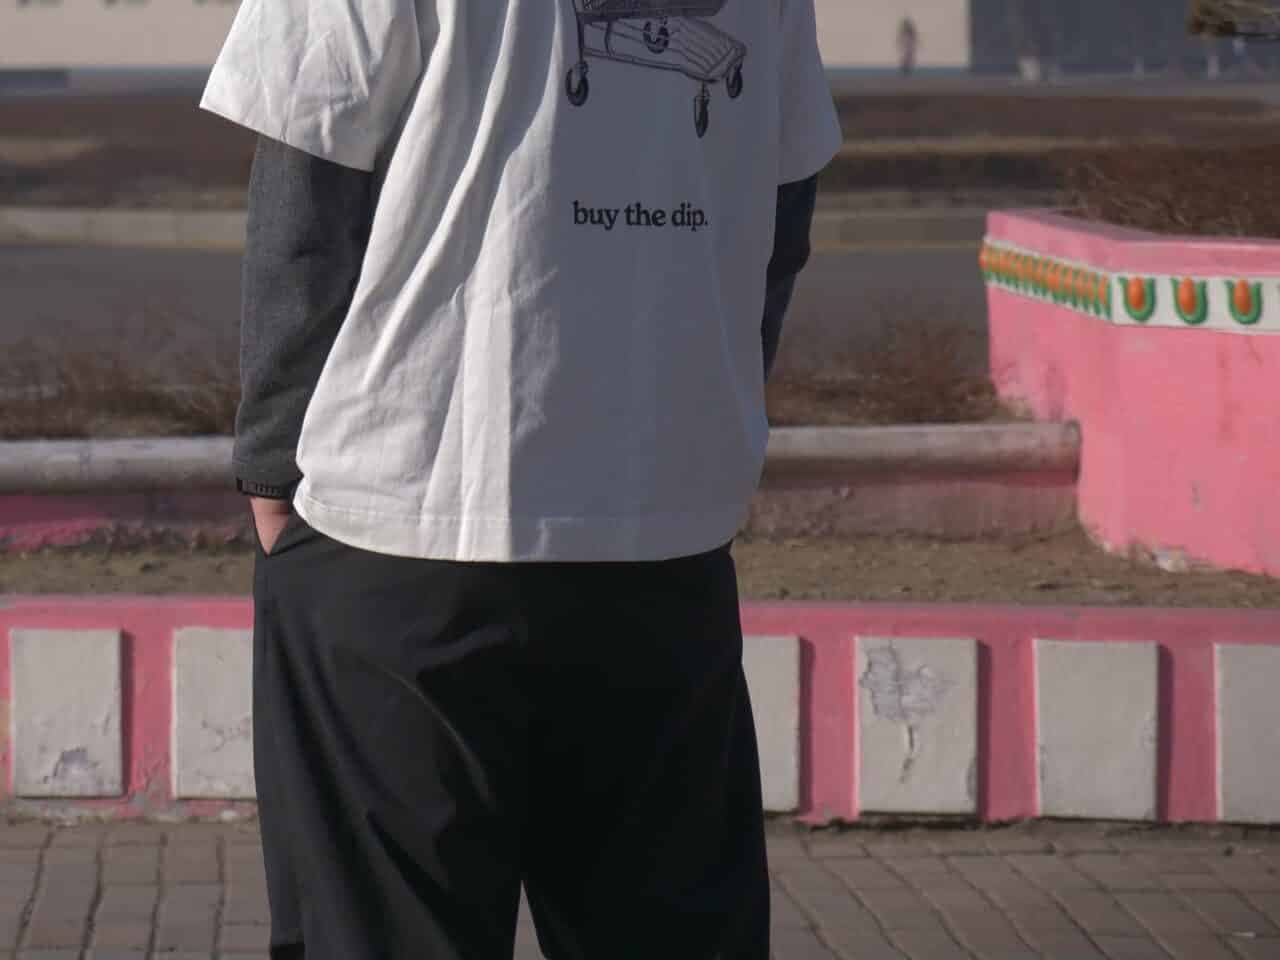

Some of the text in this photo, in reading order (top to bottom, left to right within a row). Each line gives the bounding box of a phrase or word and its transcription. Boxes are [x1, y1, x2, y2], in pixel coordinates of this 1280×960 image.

[572, 200, 708, 232] buy the dip.
